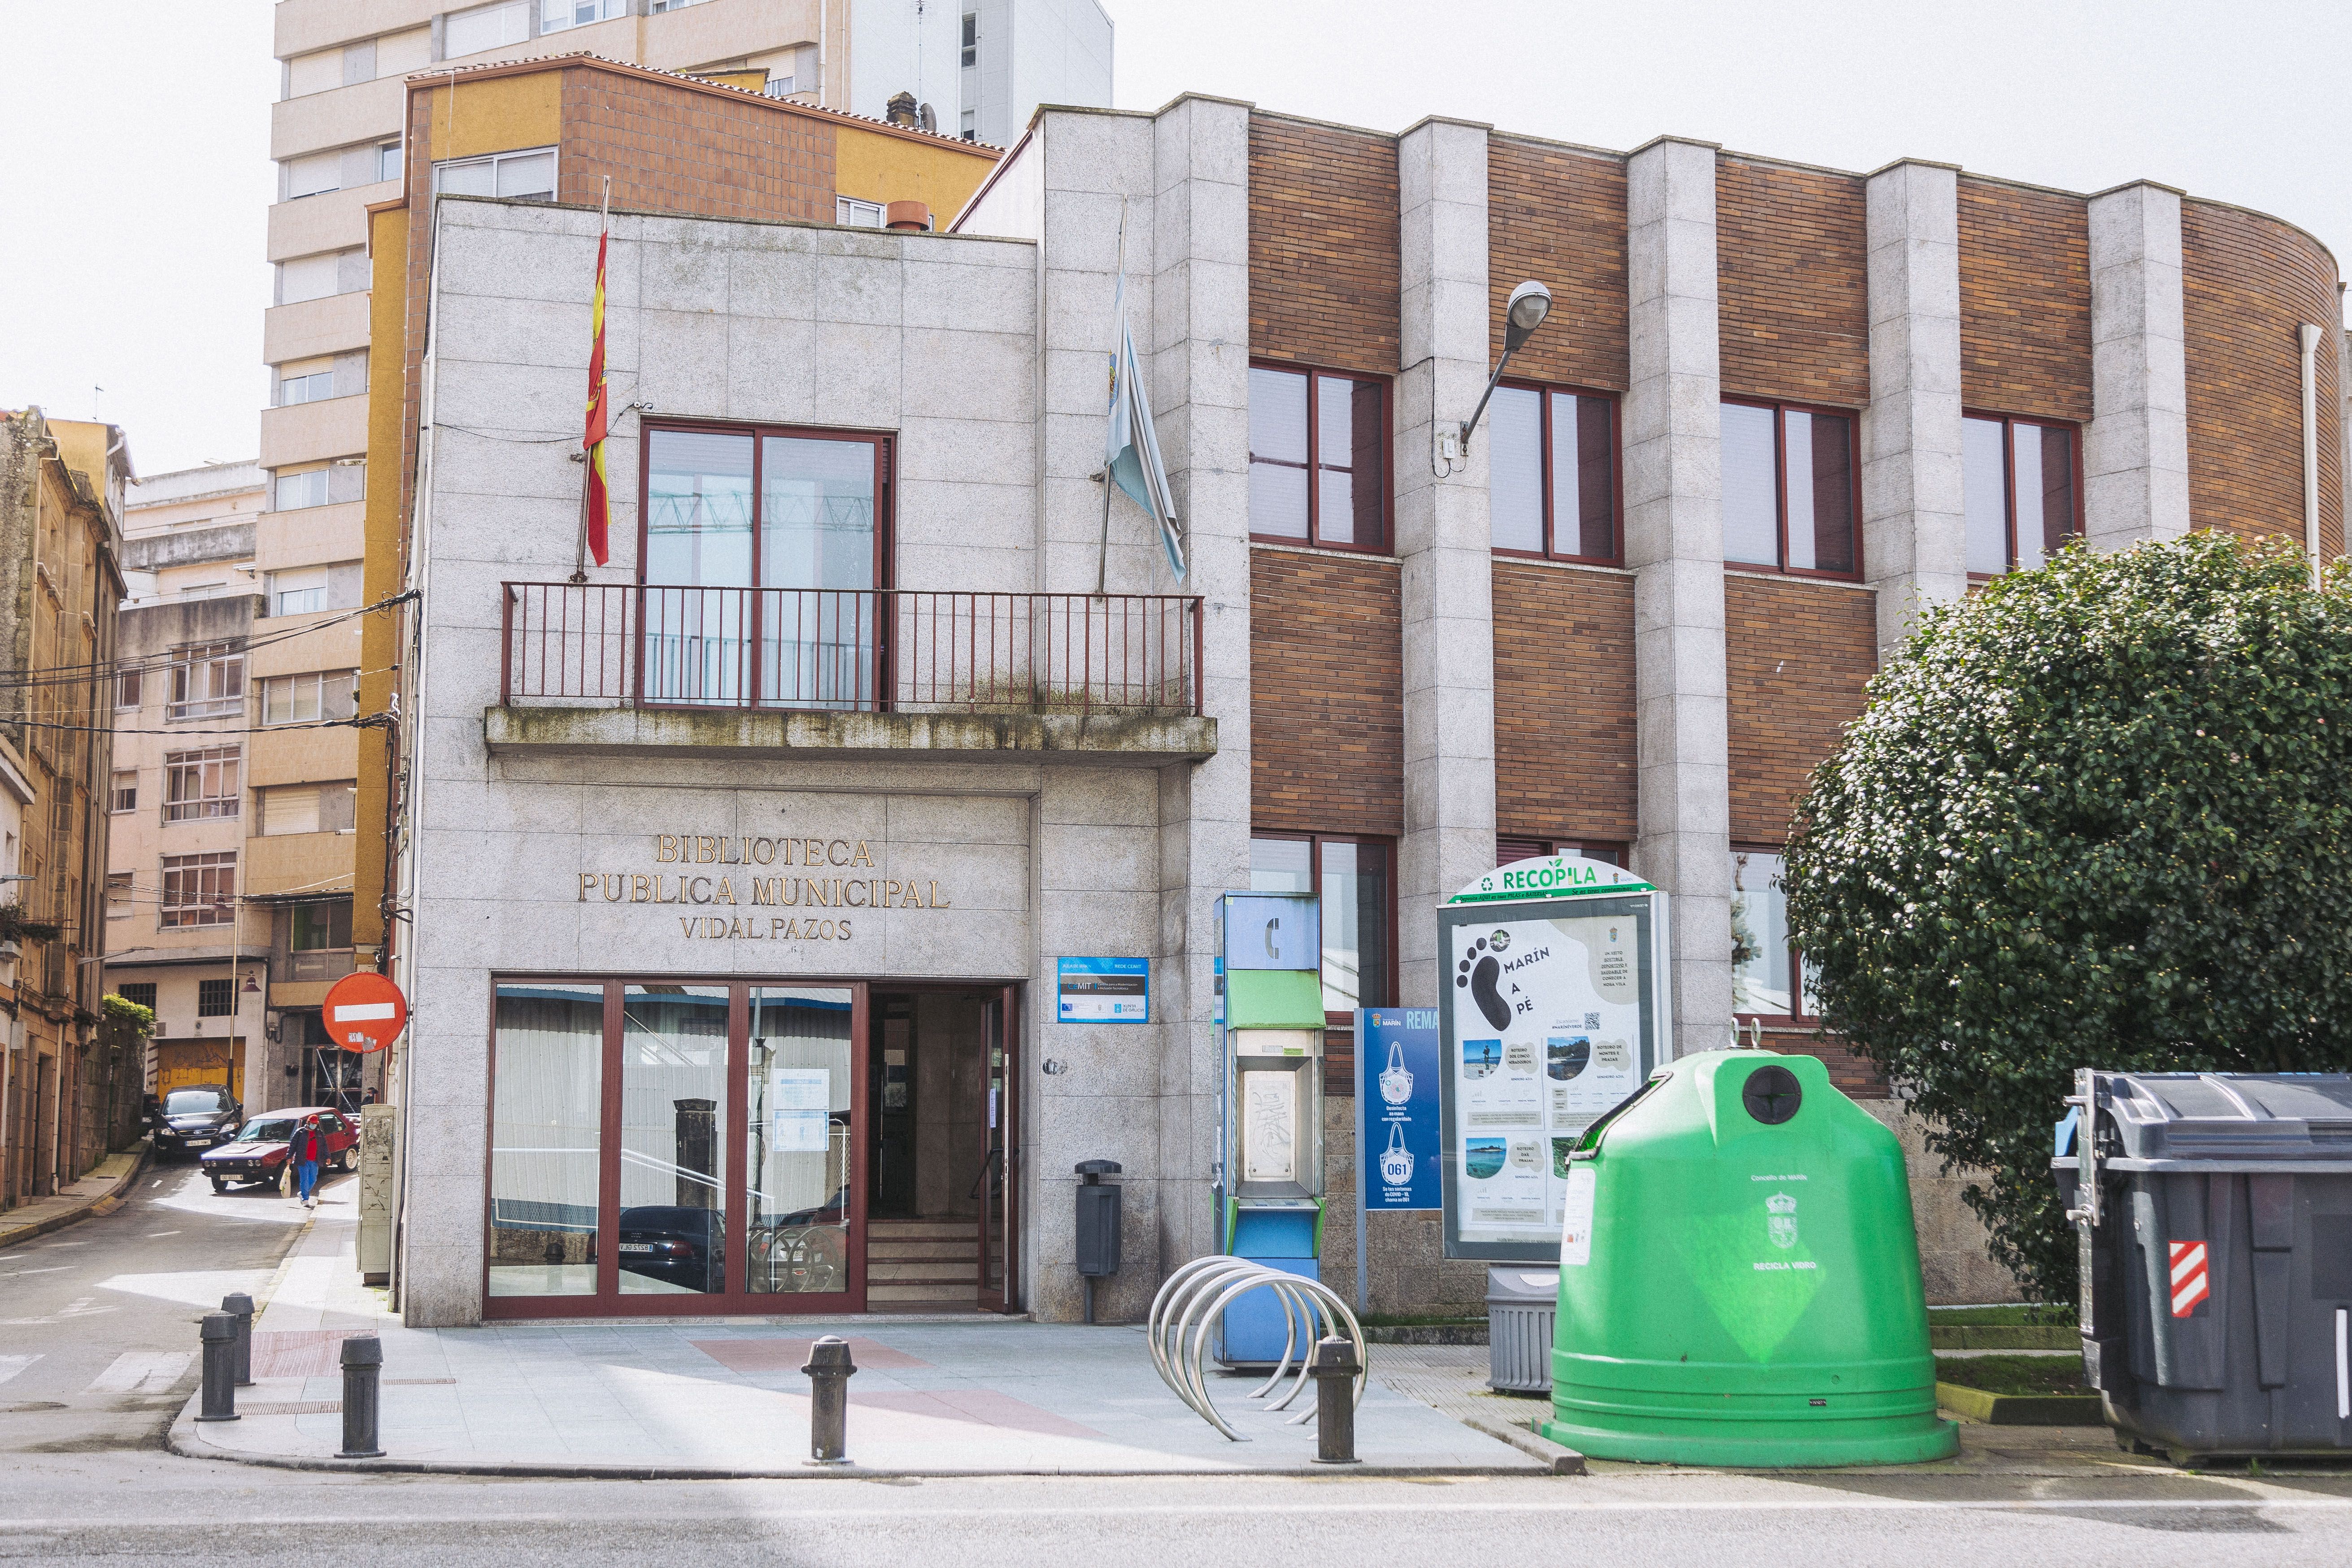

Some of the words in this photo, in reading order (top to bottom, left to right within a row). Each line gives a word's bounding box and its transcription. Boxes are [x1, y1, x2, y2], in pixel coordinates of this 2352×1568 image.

[657, 834, 875, 867] BIBLIOTECA
[1504, 866, 1597, 889] RECOPILA
[578, 873, 736, 905] PUBLICA
[753, 878, 951, 908] MUNICIPAL
[680, 917, 763, 939] VIDAL
[771, 918, 851, 940] PAZOS
[1503, 947, 1550, 974] MARÍN
[1512, 983, 1521, 995] A
[1516, 996, 1533, 1015] PÉ
[1407, 1011, 1439, 1029] REMA
[1388, 1163, 1406, 1175] 061
[1753, 1262, 1790, 1270] RECICLA
[1791, 1261, 1816, 1269] VIDRO
